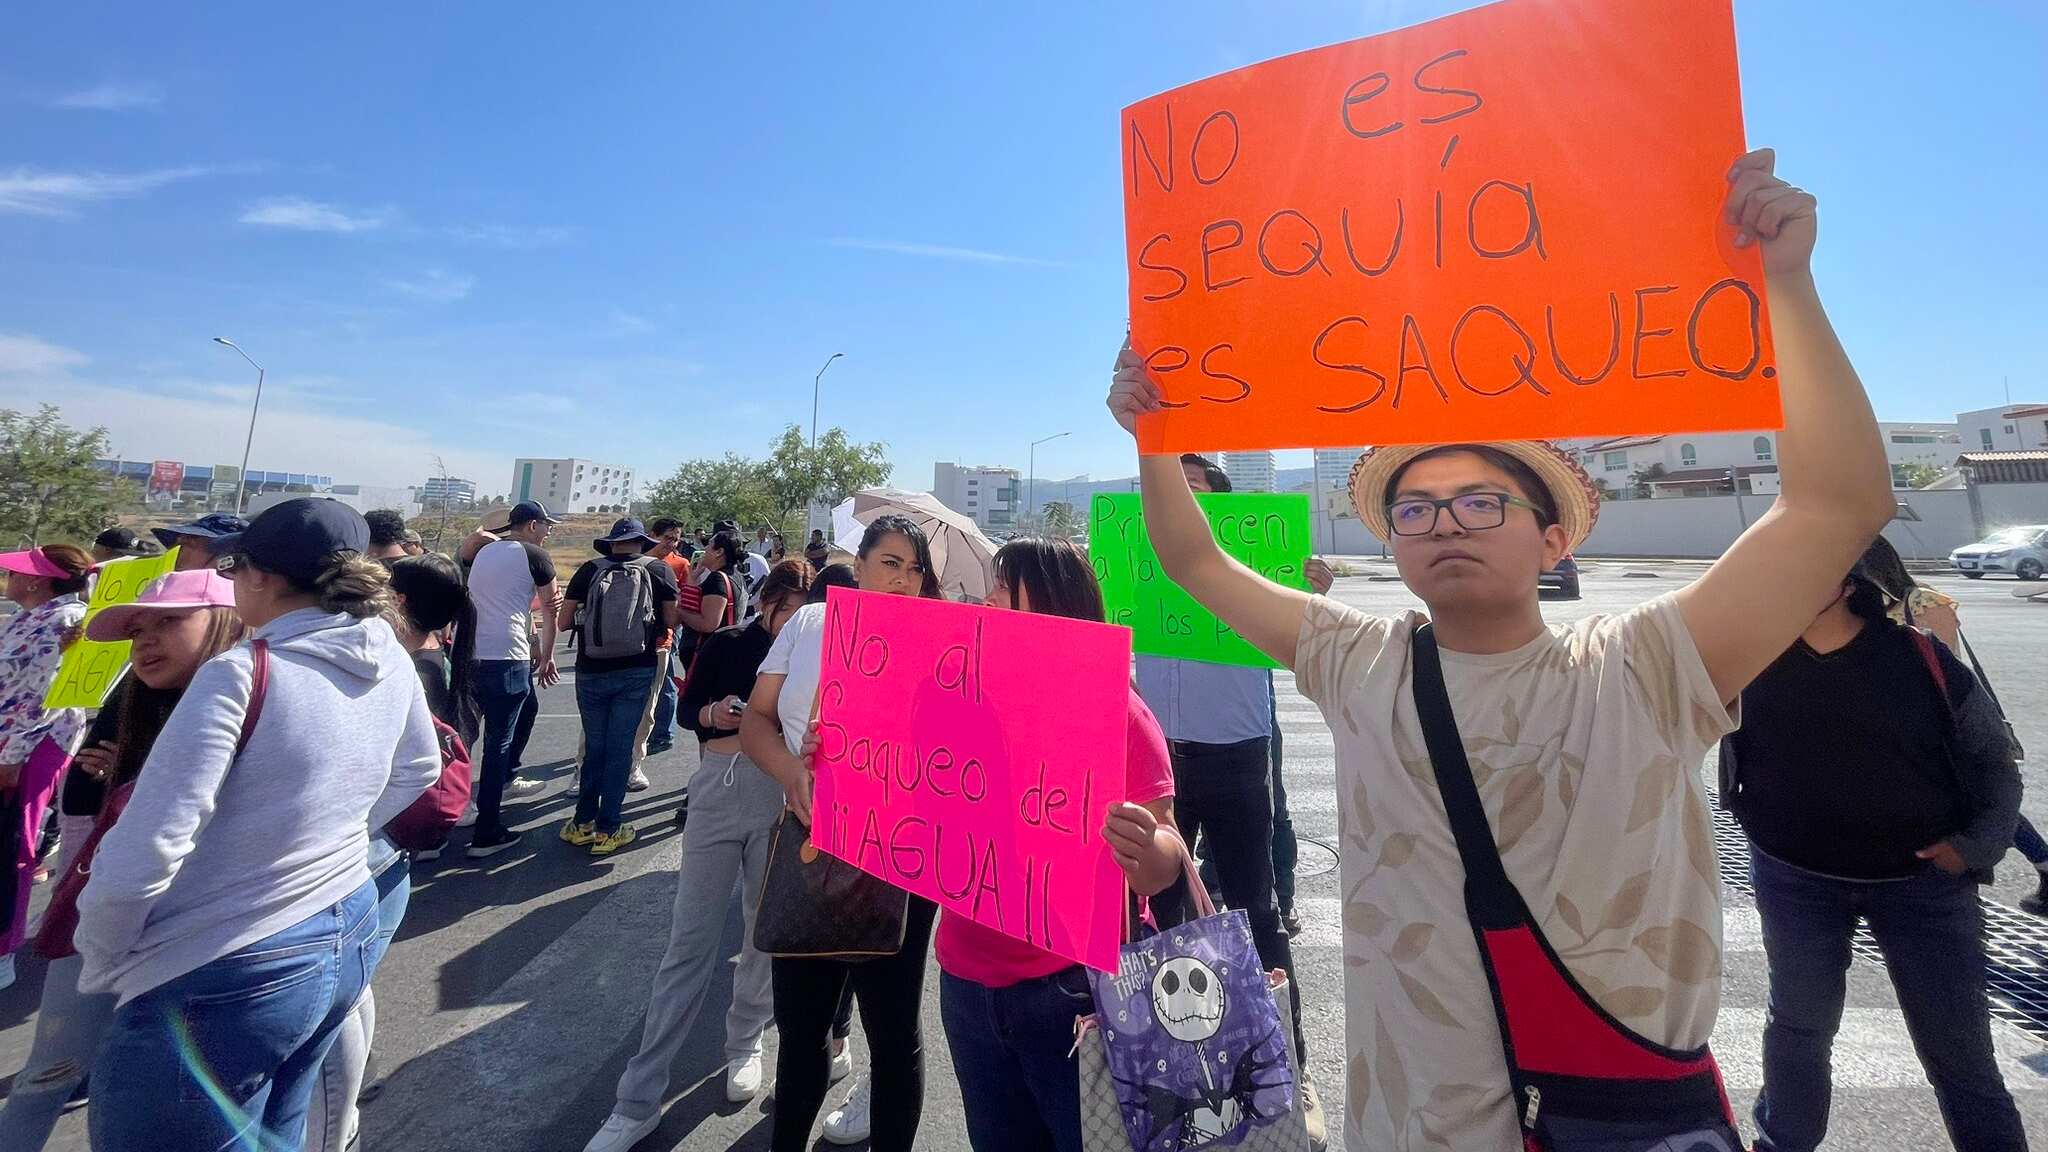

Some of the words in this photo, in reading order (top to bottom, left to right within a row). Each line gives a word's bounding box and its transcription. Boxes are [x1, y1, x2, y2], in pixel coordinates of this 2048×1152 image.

[1131, 103, 1240, 197] NO
[1341, 49, 1483, 138] es
[1144, 343, 1251, 408] es
[1312, 278, 1778, 413] SAQUEO.
[1092, 556, 1110, 581] a
[1127, 546, 1157, 584] la
[1159, 599, 1194, 636] los
[827, 597, 889, 677] No
[935, 616, 983, 704] al
[819, 680, 986, 806] Saqueo
[1020, 760, 1092, 846] del
[1113, 971, 1147, 1001] THIS?
